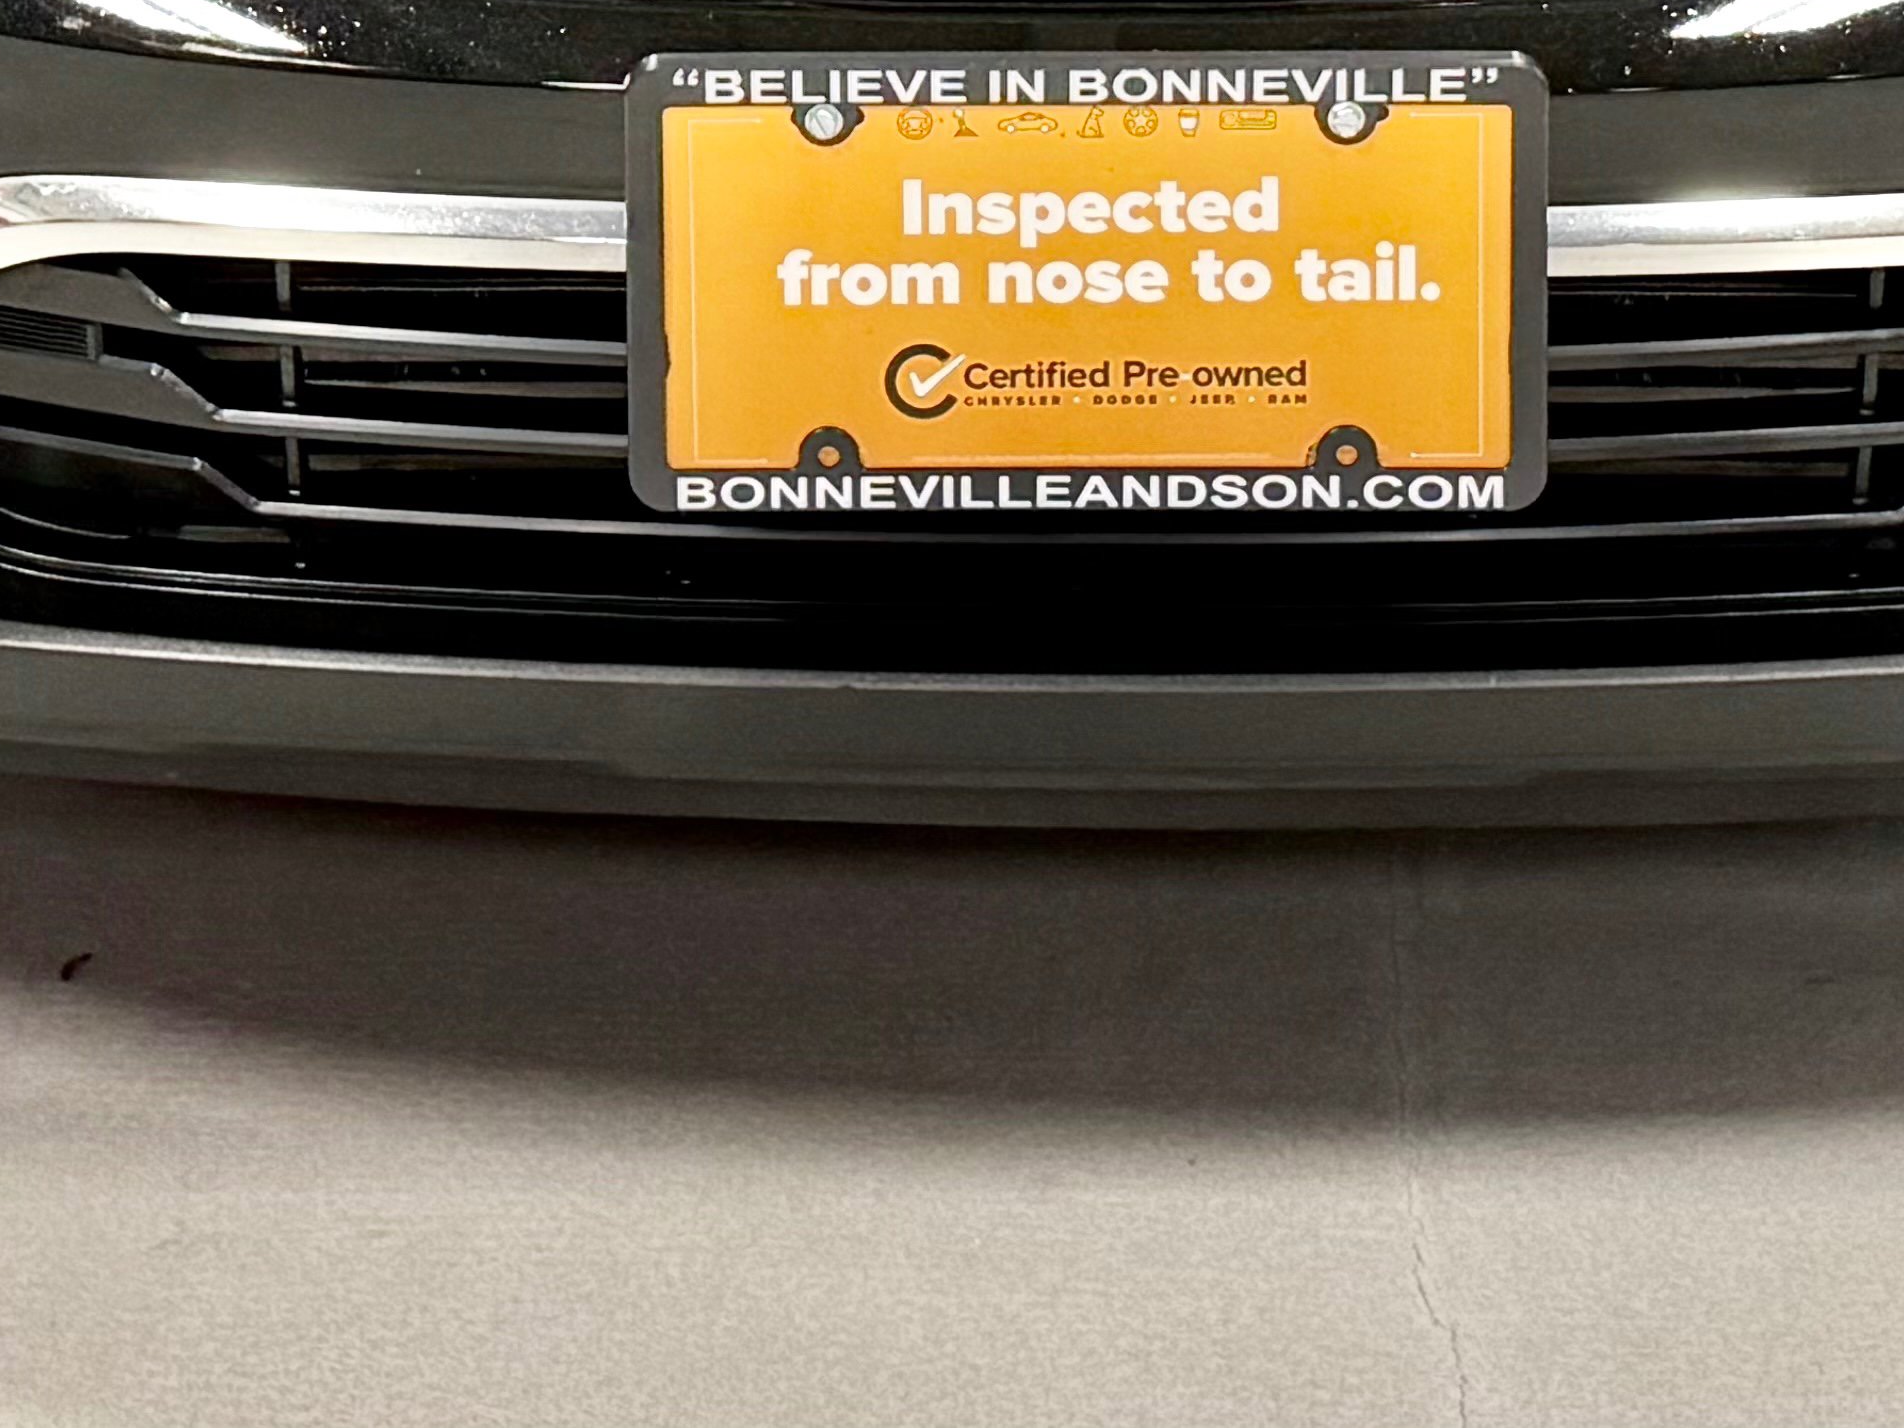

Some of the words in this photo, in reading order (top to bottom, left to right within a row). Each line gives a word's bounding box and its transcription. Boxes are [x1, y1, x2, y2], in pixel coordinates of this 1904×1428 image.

[989, 68, 1046, 104] IN
[902, 175, 1280, 248] Inspected
[777, 248, 960, 306] from
[987, 258, 1169, 304] nose
[1191, 249, 1272, 302] to
[1294, 240, 1441, 302] tail.
[963, 359, 1111, 391] Certified
[963, 395, 1063, 407] CHRYSLER
[1092, 394, 1159, 406] DODGE
[1267, 394, 1309, 405] RAM
[675, 473, 1505, 510] BONNEVILLEANDSON.COM
